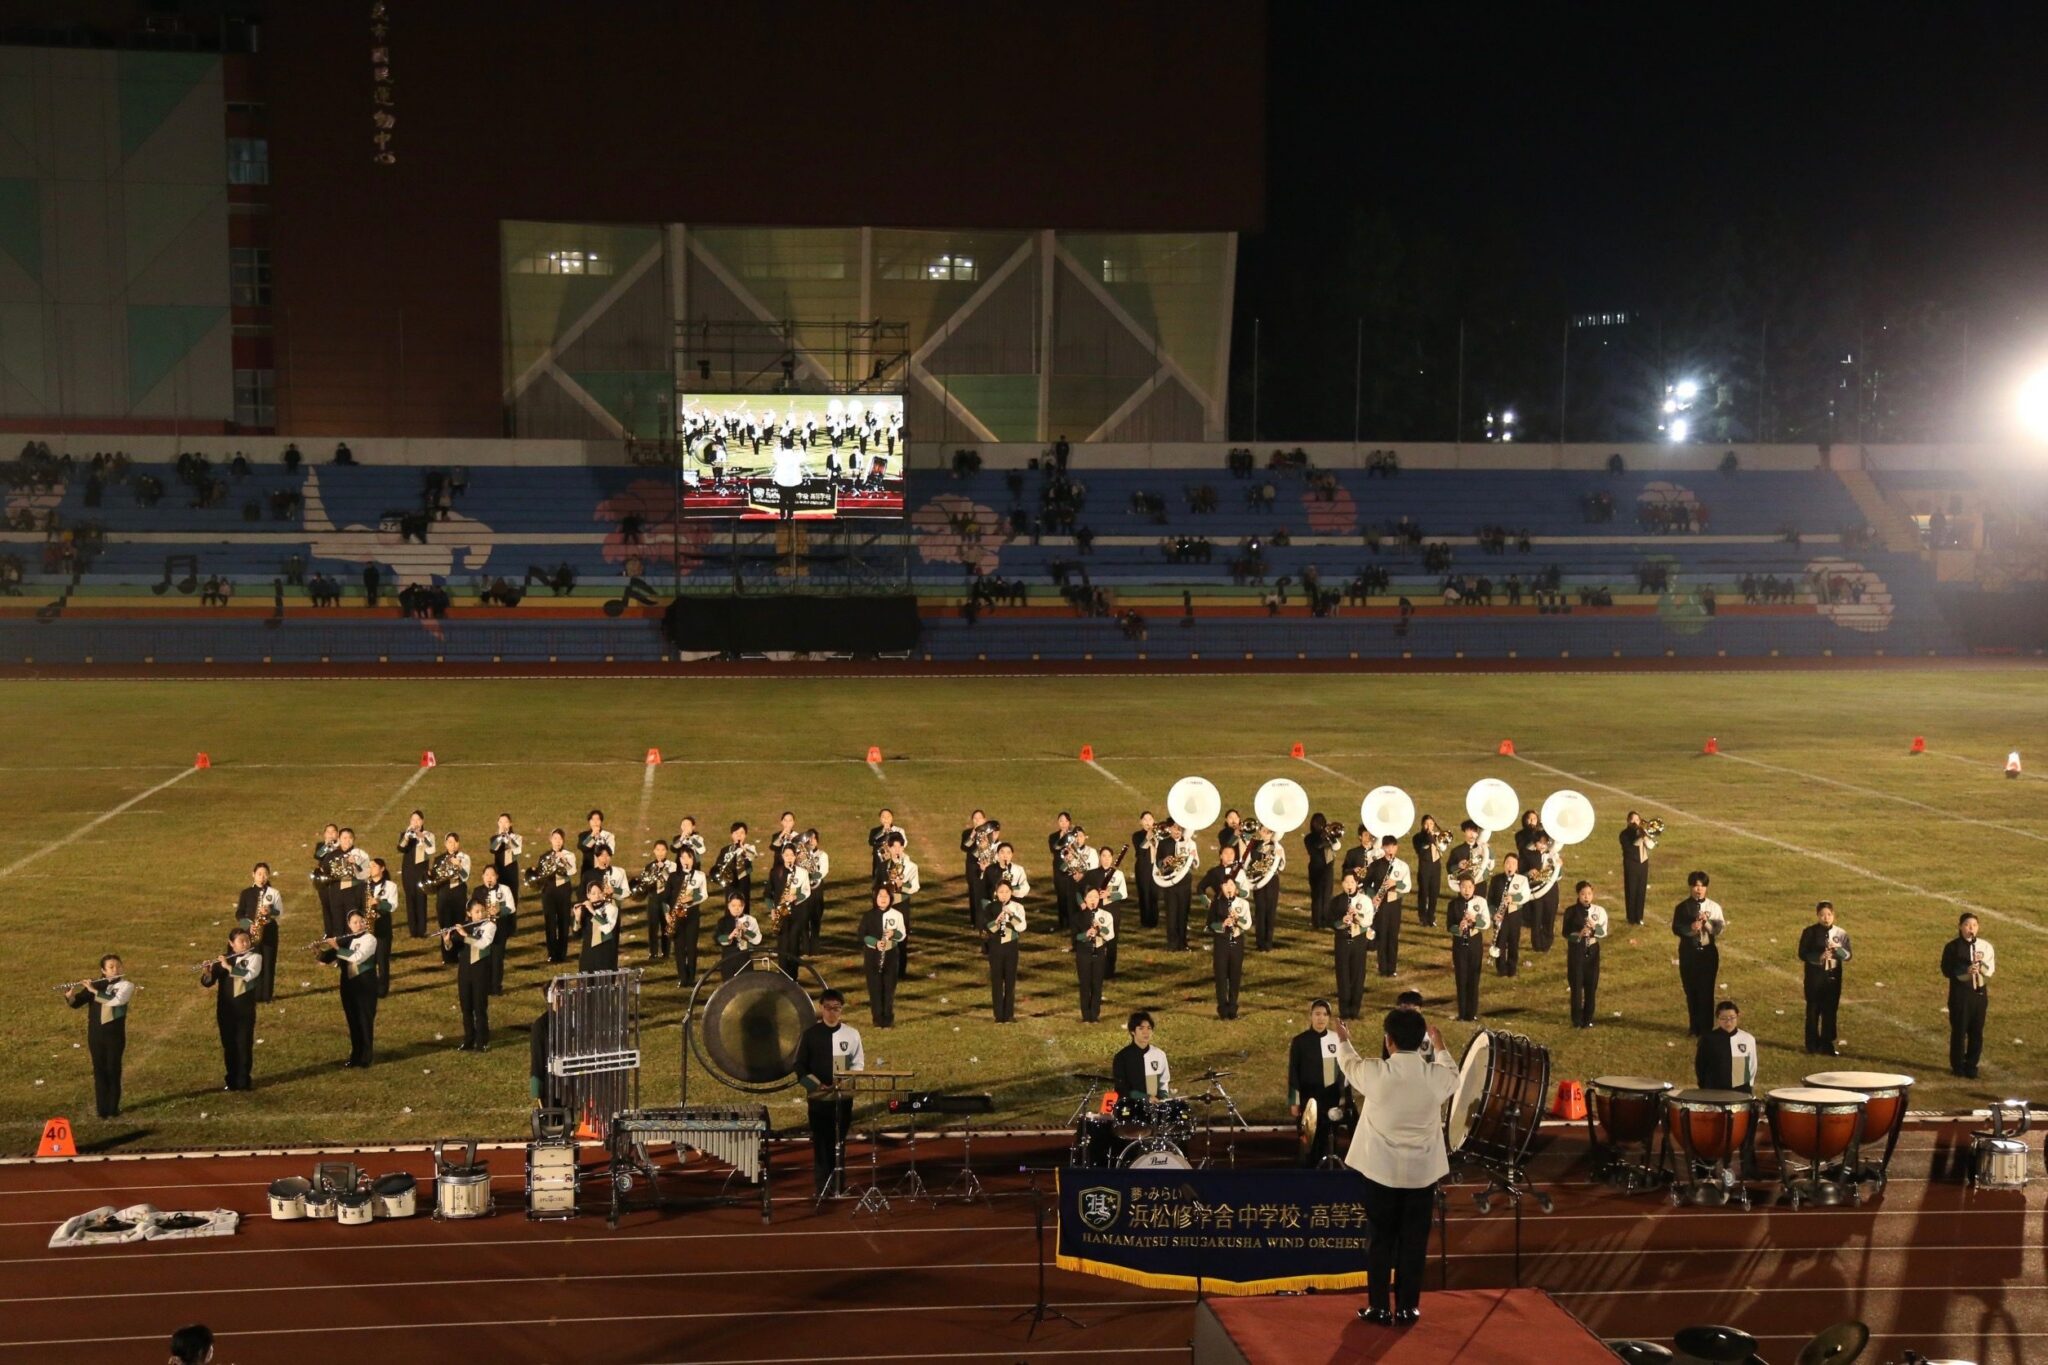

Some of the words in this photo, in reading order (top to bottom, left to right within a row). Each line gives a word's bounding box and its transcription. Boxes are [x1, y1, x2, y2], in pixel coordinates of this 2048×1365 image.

[1106, 1100, 1114, 1112] 5
[46, 1126, 67, 1140] 40
[1081, 1231, 1169, 1249] HAMAMATSU
[1172, 1235, 1262, 1249] SHUGAKUSHA
[1265, 1236, 1305, 1249] WIND
[1308, 1236, 1371, 1249] ORCHEST
